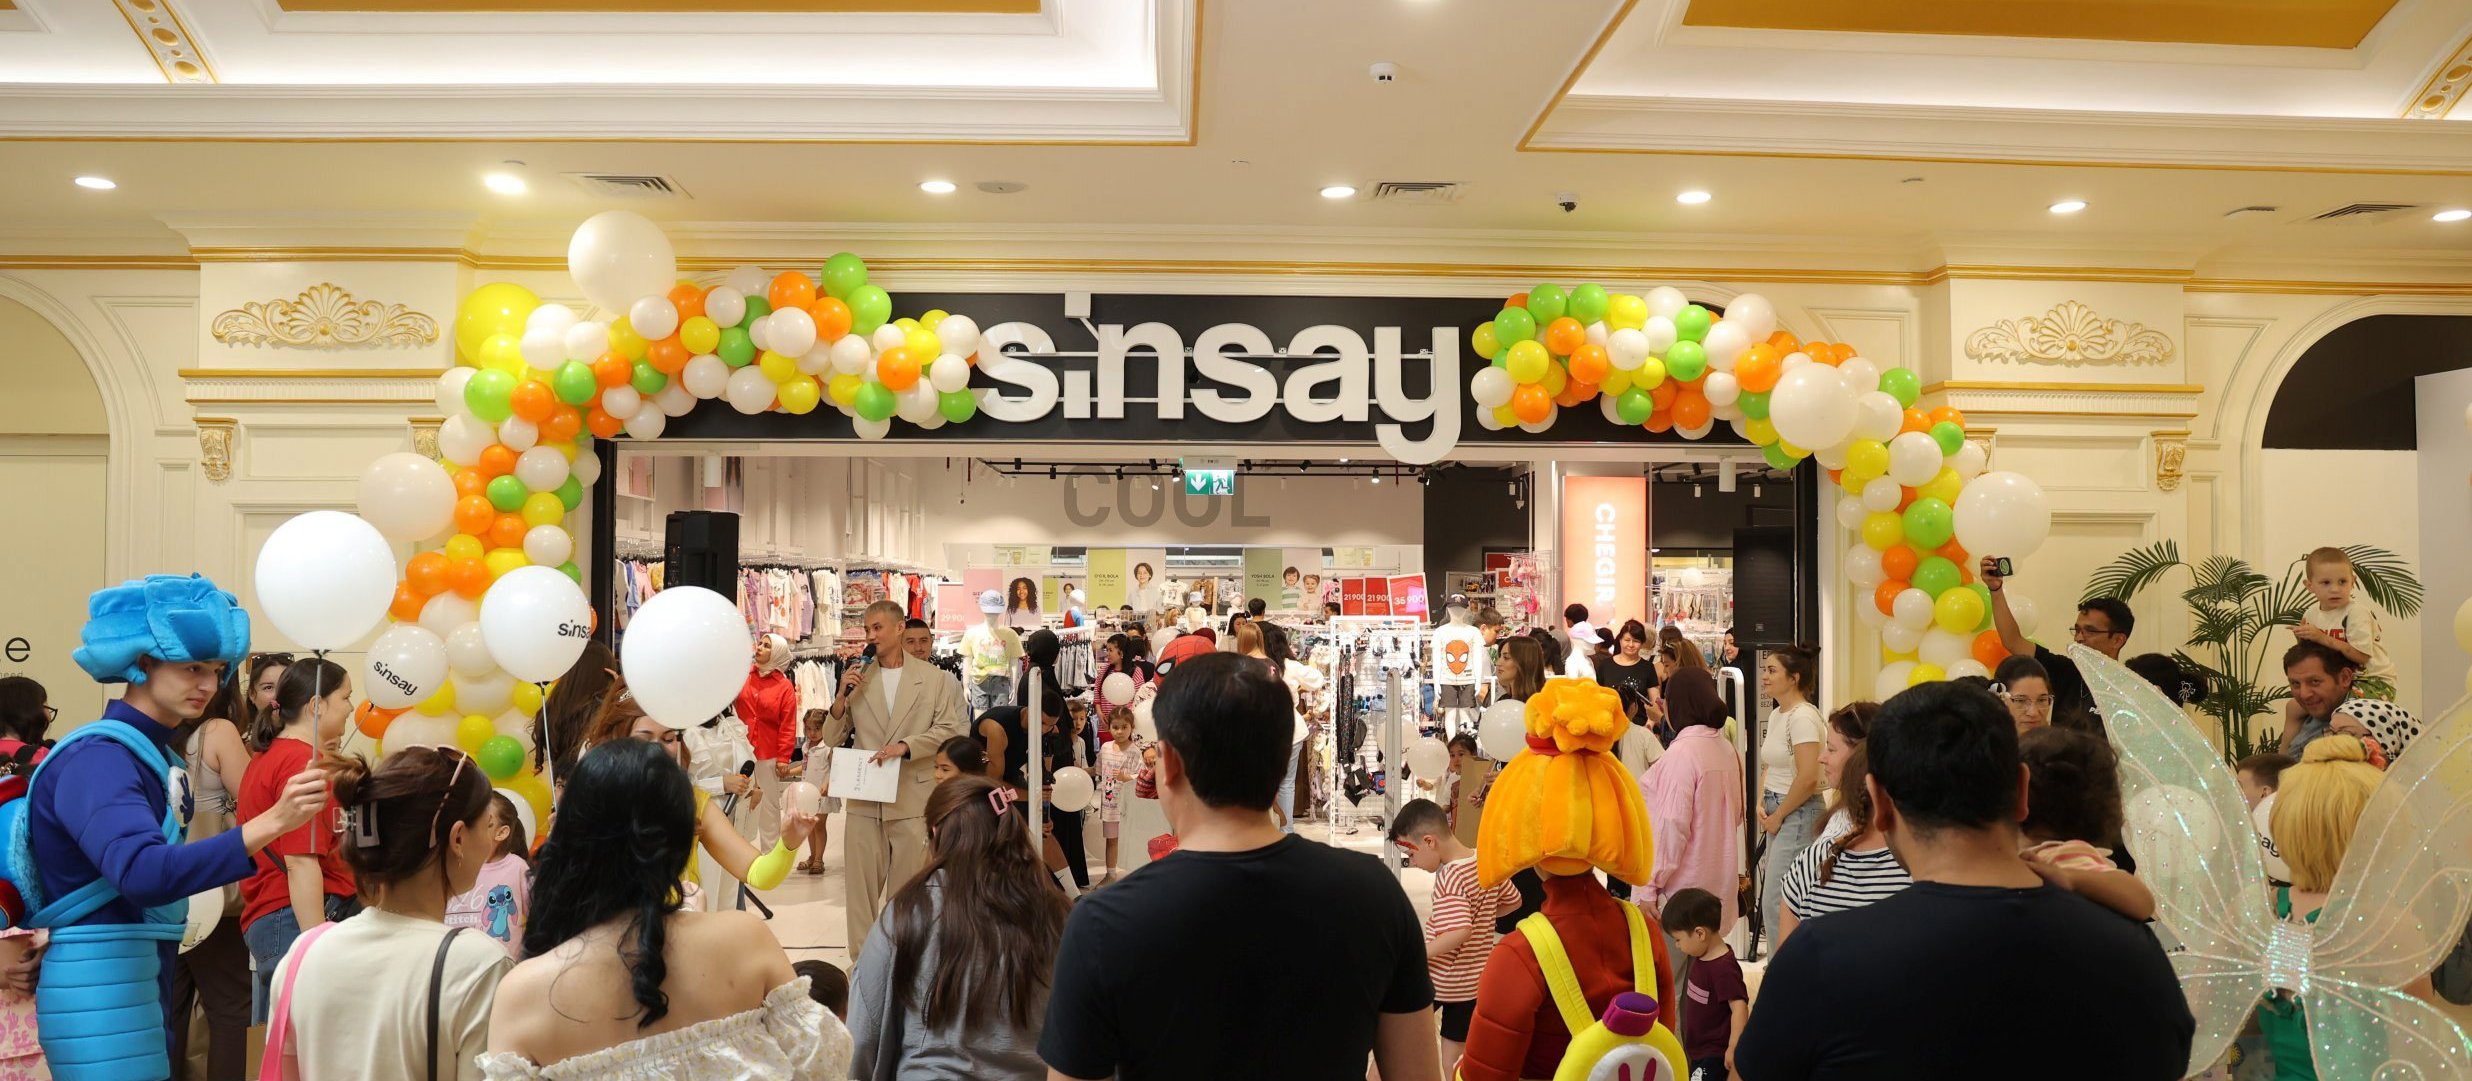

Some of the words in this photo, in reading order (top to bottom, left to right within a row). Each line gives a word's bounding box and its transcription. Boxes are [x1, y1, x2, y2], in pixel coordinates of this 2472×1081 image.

[972, 291, 1462, 464] sinsay
[1063, 465, 1271, 528] COOL
[373, 661, 418, 696] sinsay
